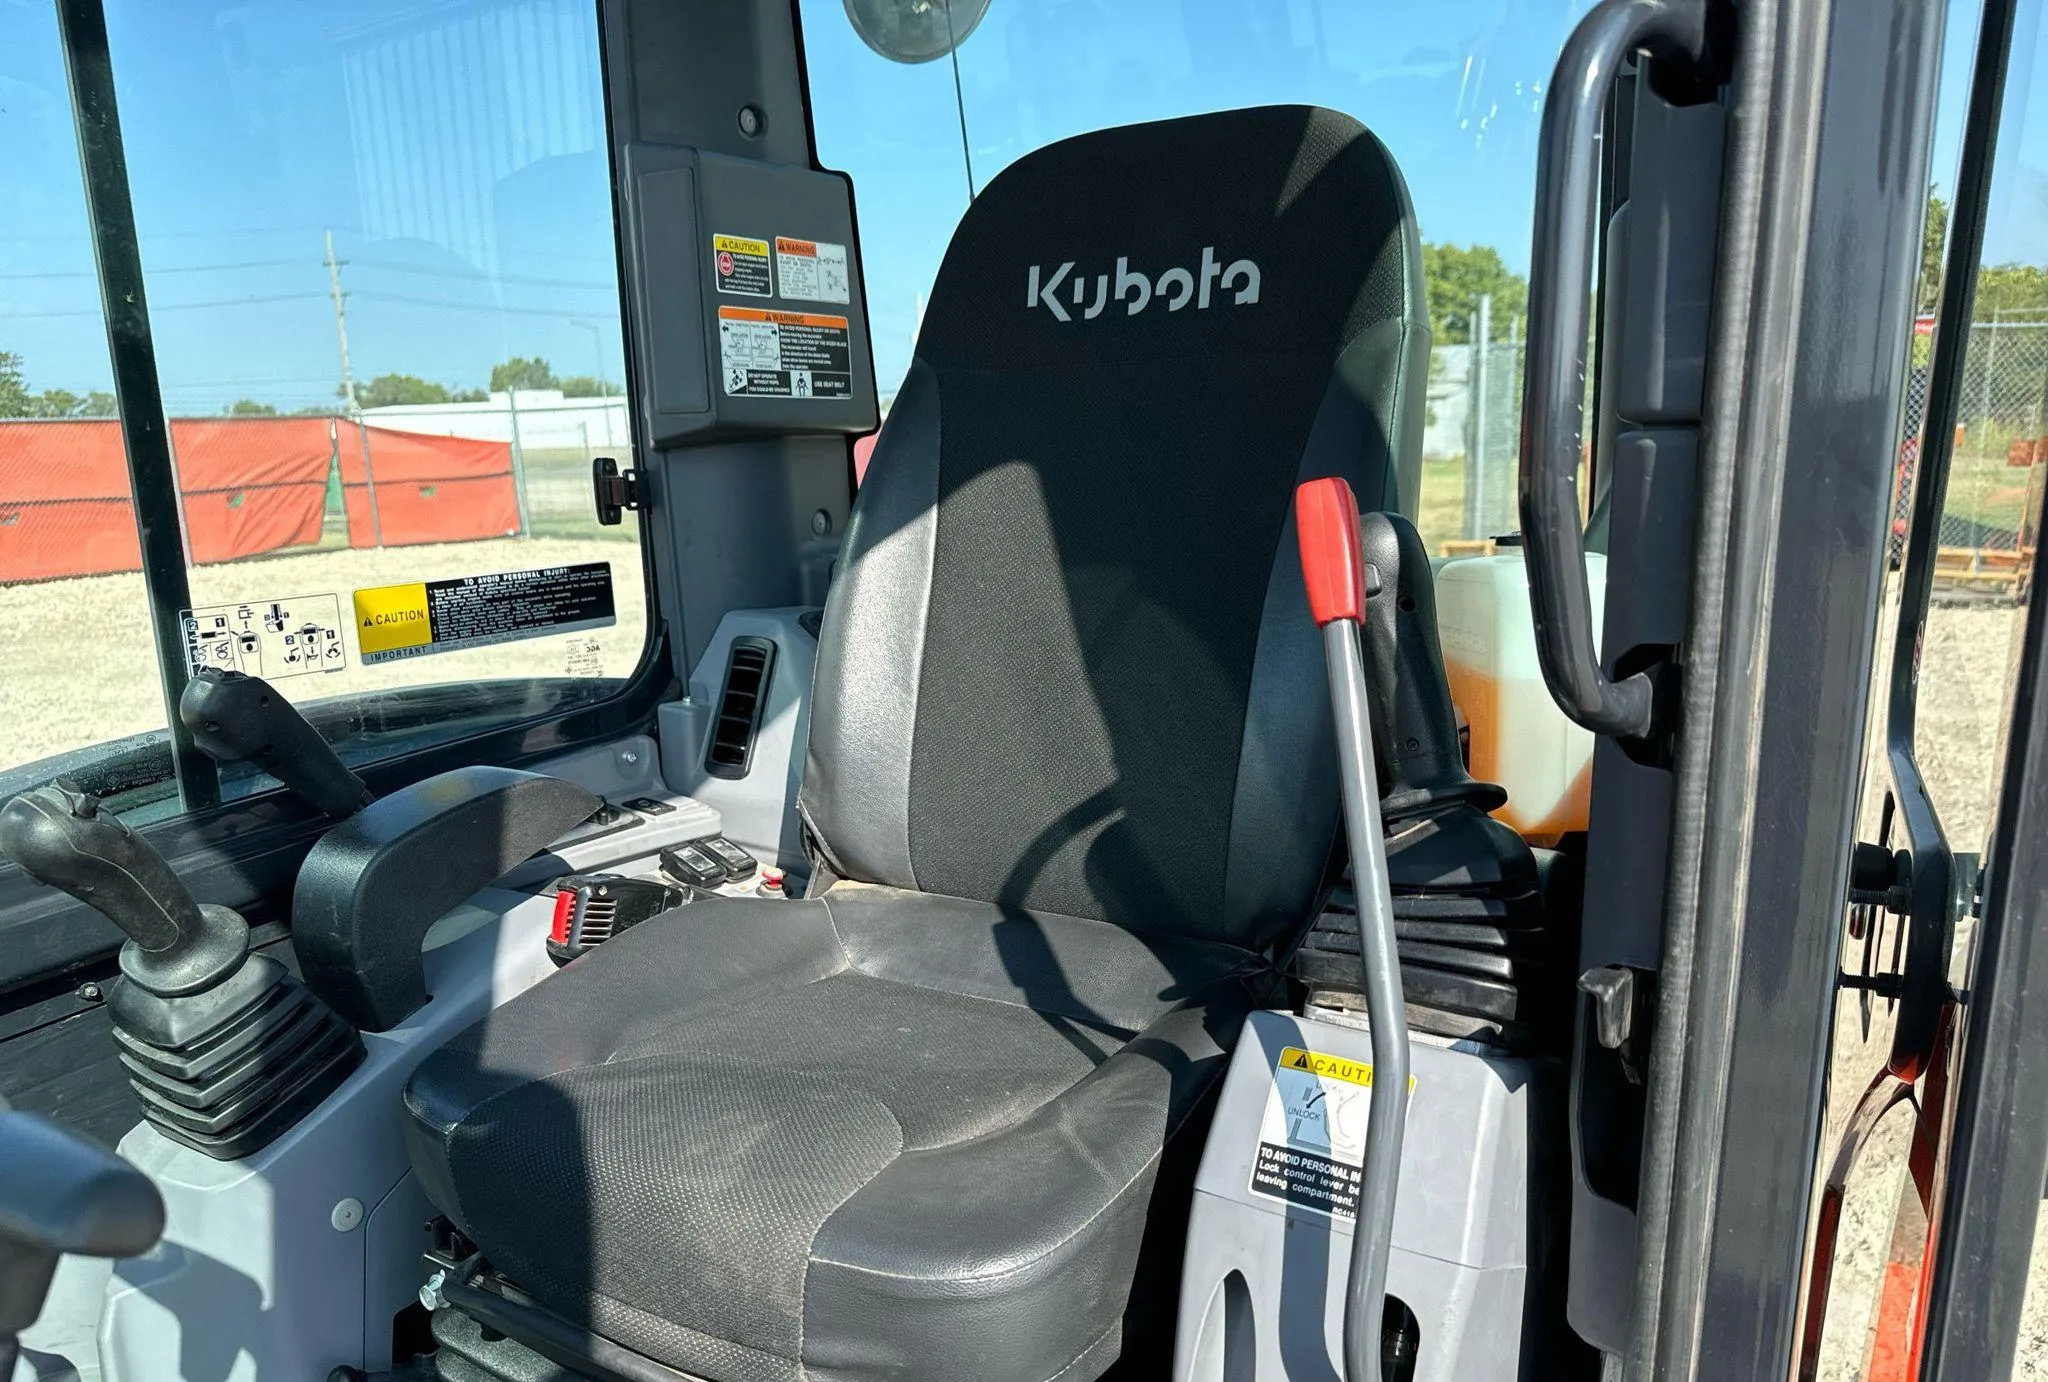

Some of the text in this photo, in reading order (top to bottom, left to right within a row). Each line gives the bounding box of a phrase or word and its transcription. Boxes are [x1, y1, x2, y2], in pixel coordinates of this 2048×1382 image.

[729, 241, 761, 253] CAUTION
[786, 245, 815, 254] WARNING
[1027, 246, 1261, 322] Kubota
[772, 312, 804, 324] WARNING
[464, 568, 570, 586] TO AVOID PERSONAL INJURY:
[375, 609, 424, 625] CAUTION
[286, 636, 293, 644] 2
[370, 645, 427, 662] IMPORTANT
[1314, 1059, 1372, 1083] CAUTI
[1288, 1106, 1321, 1121] UNLOCK
[1261, 1147, 1273, 1159] TO
[1273, 1150, 1300, 1166] AVOID
[1301, 1158, 1349, 1180] PERSONAL
[1259, 1159, 1280, 1174] Lock
[1284, 1168, 1316, 1183] control
[1320, 1176, 1344, 1190] lever
[1256, 1171, 1354, 1207] leaving compartment.
